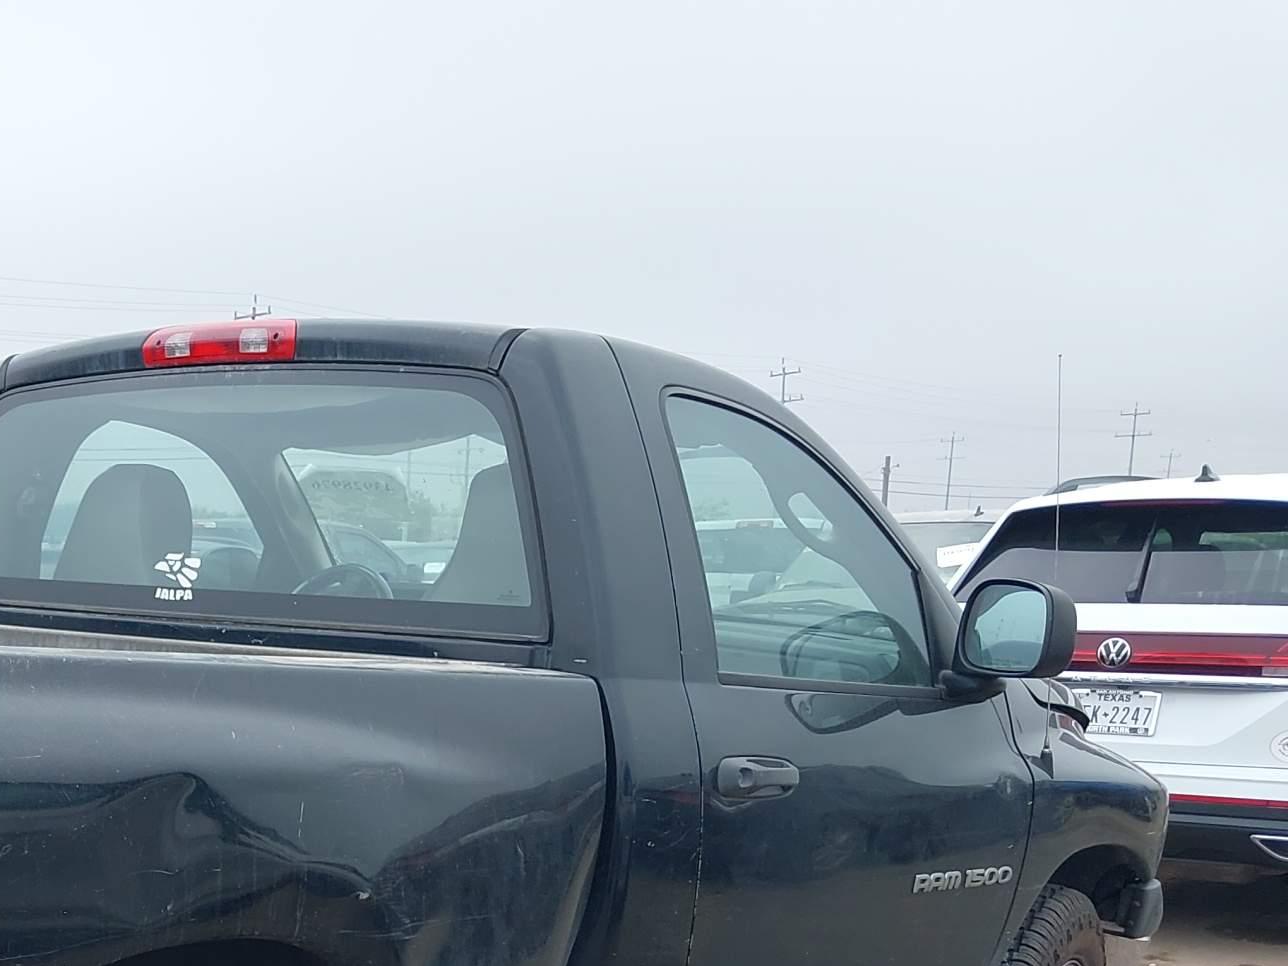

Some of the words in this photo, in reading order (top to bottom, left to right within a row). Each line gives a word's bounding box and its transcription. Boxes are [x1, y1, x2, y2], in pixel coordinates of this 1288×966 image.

[1097, 693, 1132, 703] TEXAS
[912, 870, 962, 894] RAM
[964, 865, 1013, 889] 1500
